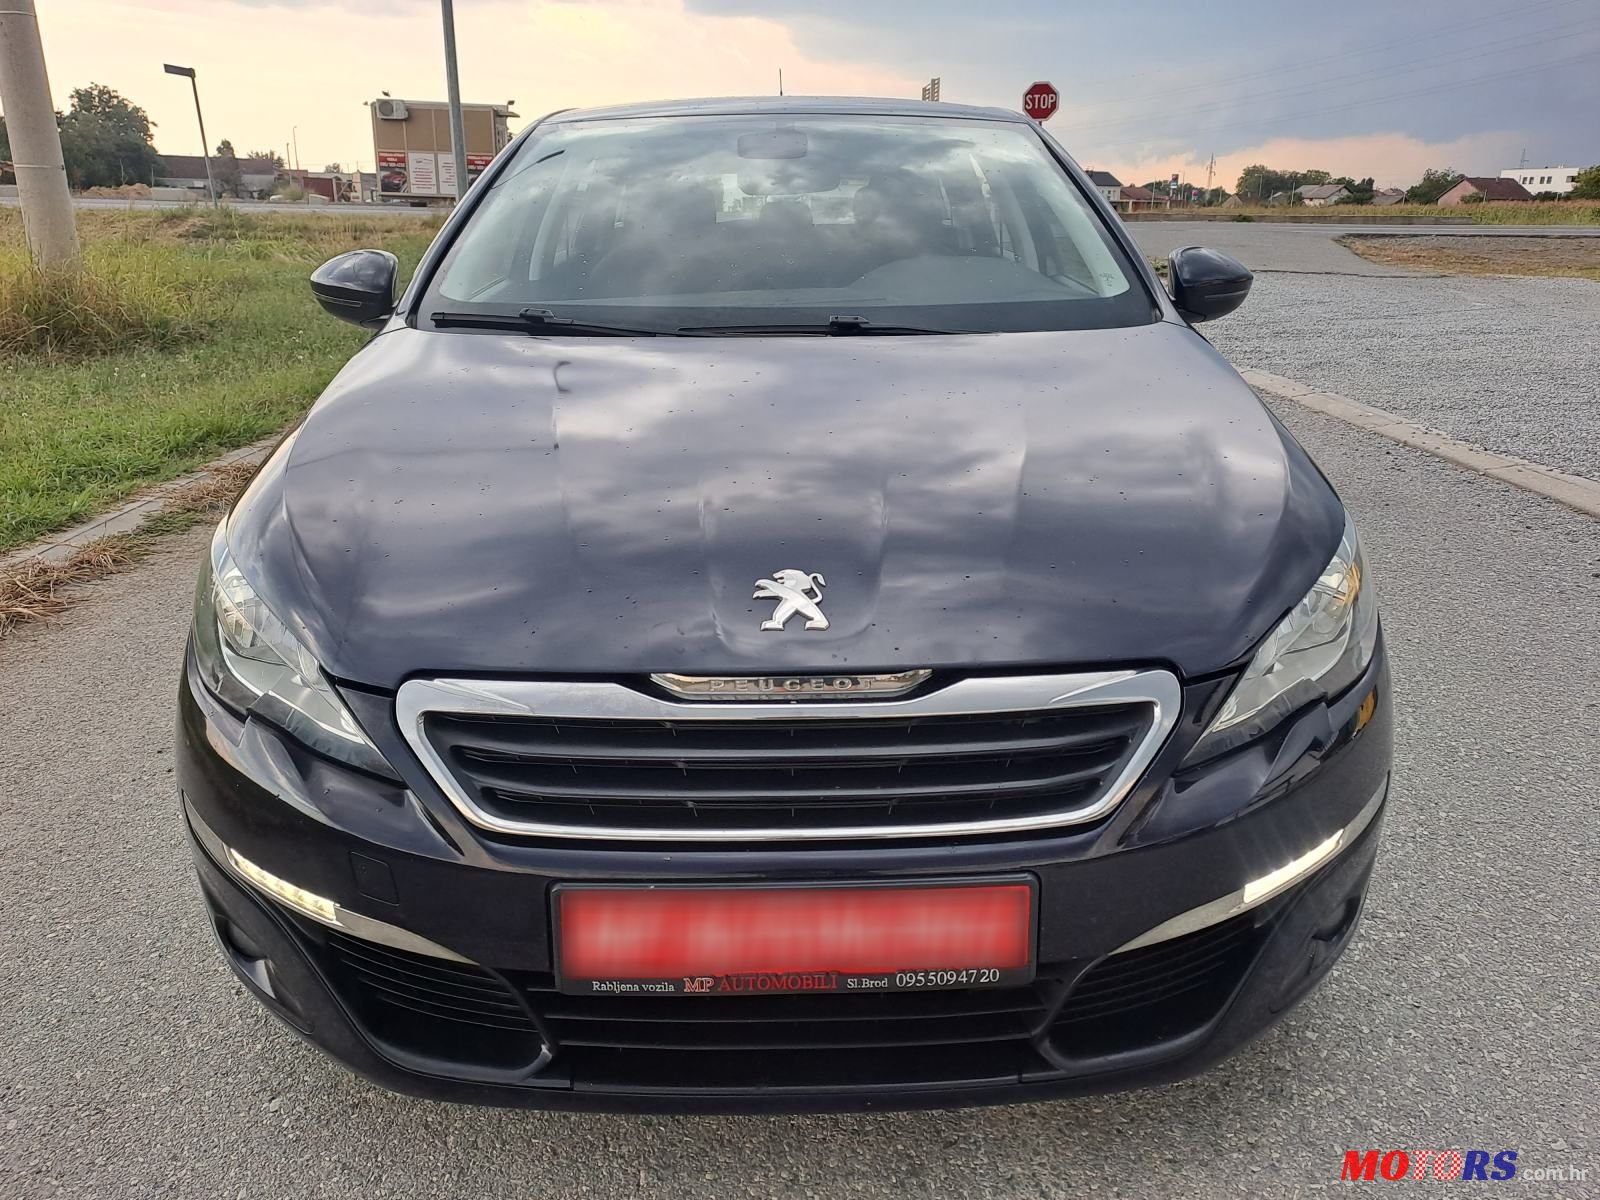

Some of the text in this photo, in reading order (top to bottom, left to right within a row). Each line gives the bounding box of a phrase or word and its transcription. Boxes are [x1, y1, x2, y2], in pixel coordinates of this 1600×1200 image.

[1025, 94, 1056, 110] STOP
[709, 678, 872, 692] PEUGEOT
[592, 981, 640, 994] Rabljena
[642, 982, 675, 993] vozila
[683, 977, 715, 993] MP
[718, 974, 838, 992] AUTOMOBILI
[896, 968, 1000, 988] 0955094720
